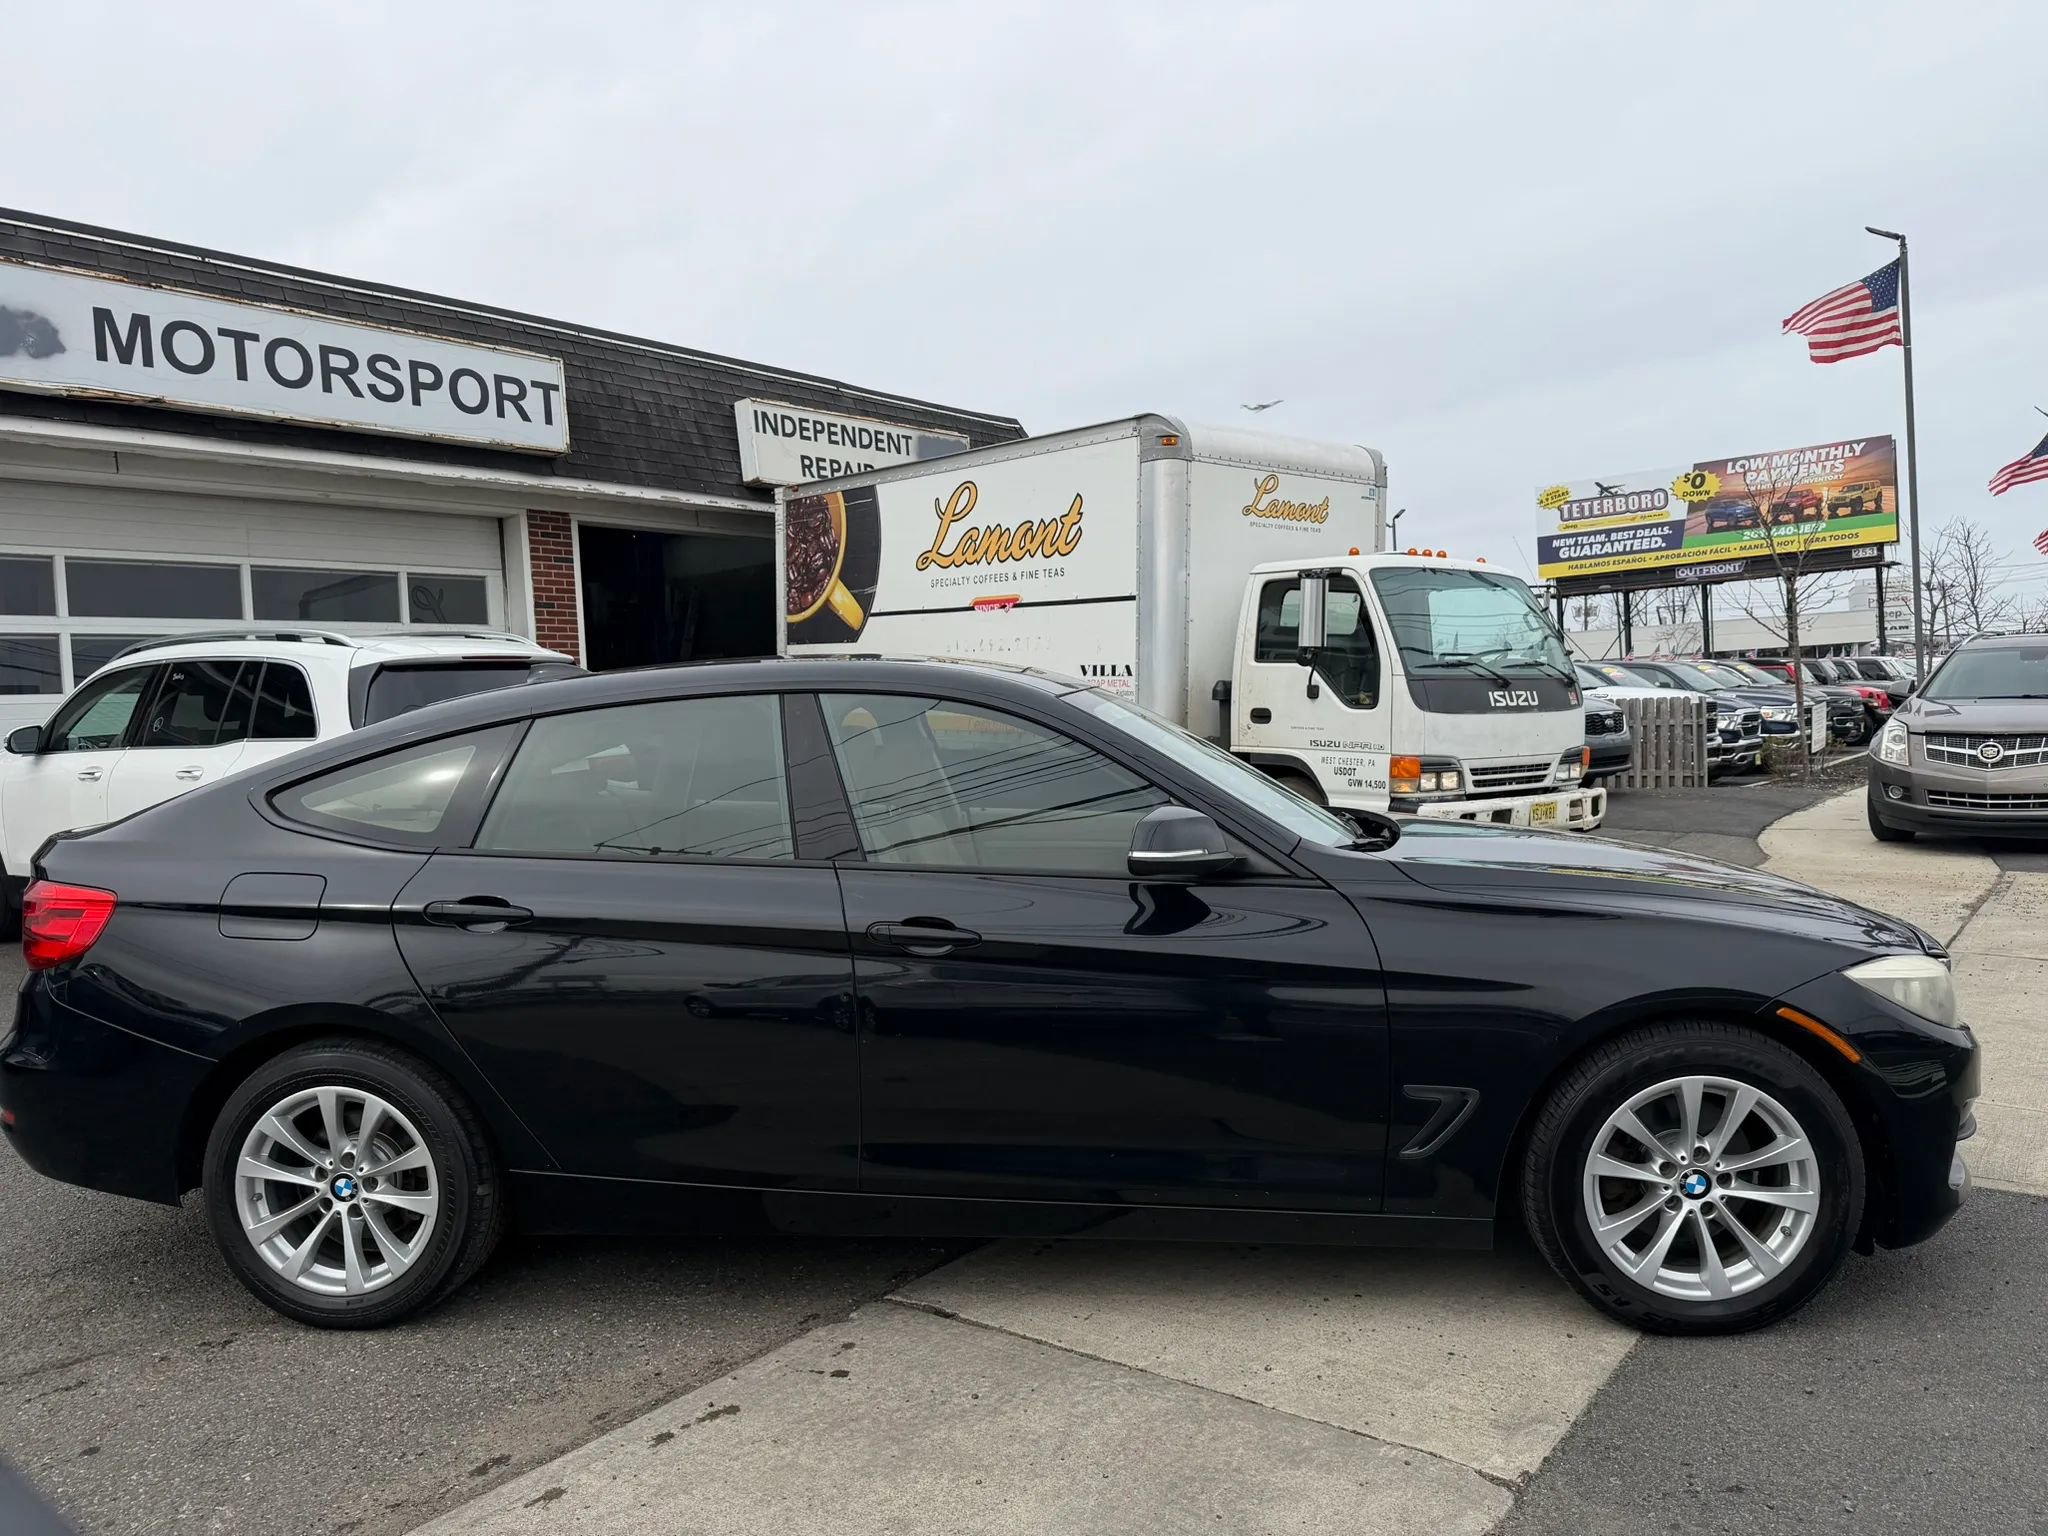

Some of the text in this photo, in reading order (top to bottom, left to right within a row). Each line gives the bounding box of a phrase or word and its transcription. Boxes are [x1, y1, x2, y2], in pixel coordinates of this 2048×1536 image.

[92, 306, 560, 426] MOTORSPORT
[754, 409, 913, 456] INDEPENDENT
[800, 455, 875, 478] REPA
[1726, 442, 1866, 474] LOW MONTHLY
[1745, 459, 1845, 484] PAYMENTS
[1242, 474, 1330, 524] Lamont
[1682, 490, 1711, 498] DOWN
[1560, 491, 1666, 520] TETERBORO
[916, 480, 1084, 572] Lamont
[1552, 526, 1673, 548] NEW TEAM. BEST DEALS.
[1559, 536, 1667, 559] GUARANTEED.
[1568, 560, 1611, 571] HABLAMOS
[1612, 556, 1648, 567] ESPAÑOL
[1777, 539, 1796, 547] HOY
[1829, 532, 1860, 541] TODOS
[930, 567, 1065, 588] SPECIALTY COFFEES & FINE TEAS
[1678, 562, 1741, 577] OUTFRONT
[1080, 664, 1133, 677] VILLA
[1107, 679, 1130, 688] METAL
[1488, 690, 1539, 707] ISUZU
[1309, 739, 1341, 748] ISUZU
[1321, 756, 1336, 765] WEST
[1368, 759, 1376, 767] PA
[1333, 766, 1357, 776] USDOT
[1347, 779, 1387, 790] GVW 14,500
